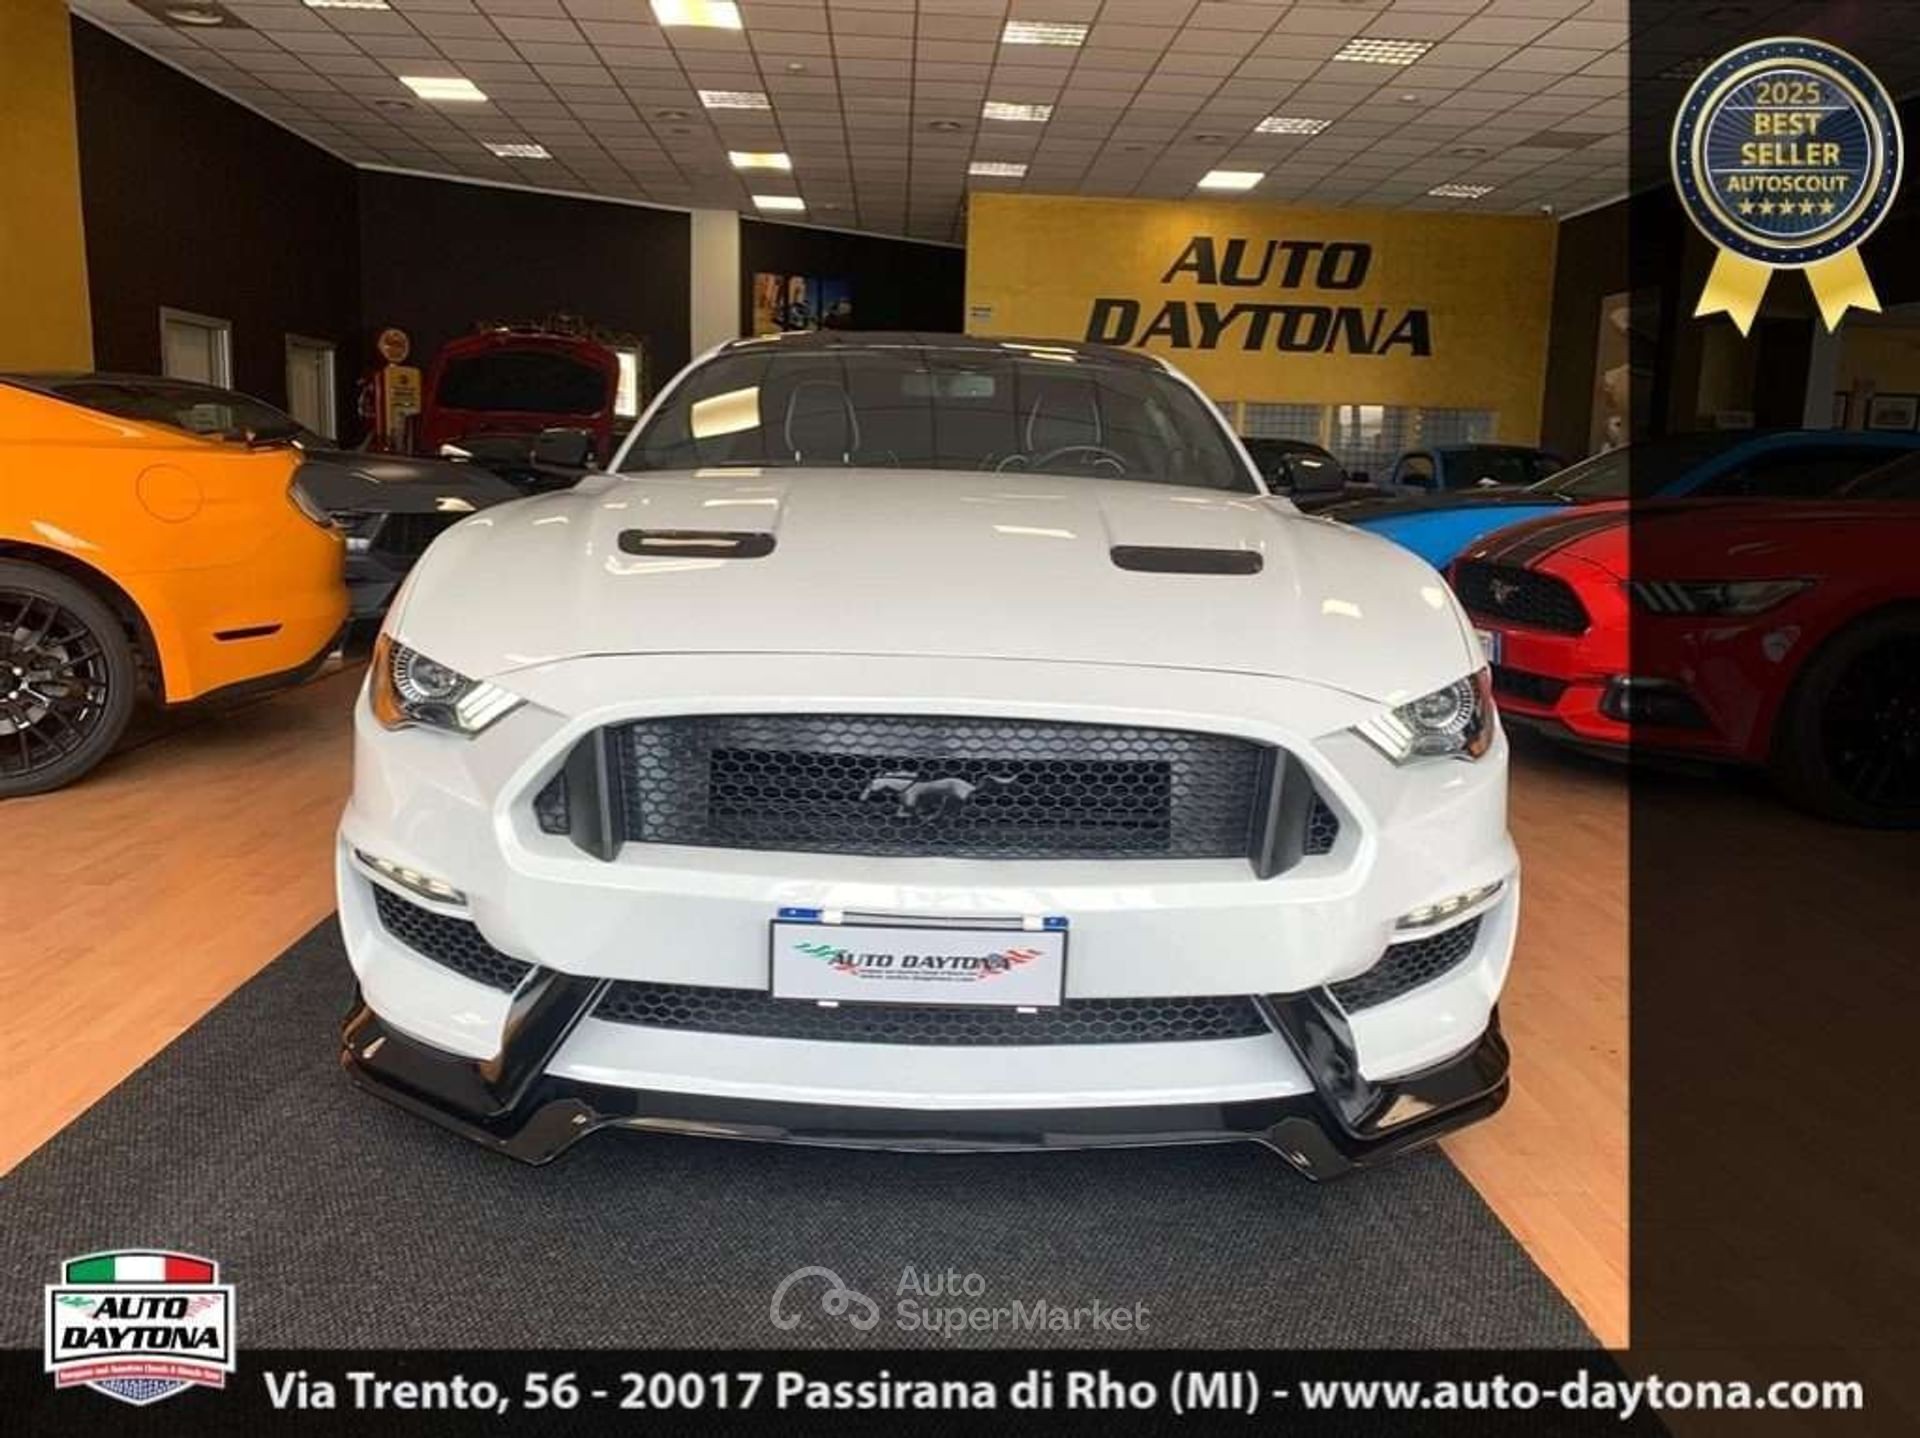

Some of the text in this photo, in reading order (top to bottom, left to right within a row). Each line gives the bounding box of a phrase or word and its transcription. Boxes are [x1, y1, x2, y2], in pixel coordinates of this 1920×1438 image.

[1161, 236, 1372, 289] AUTO
[1085, 298, 1431, 356] DAYTONA
[828, 952, 893, 968] AUTO
